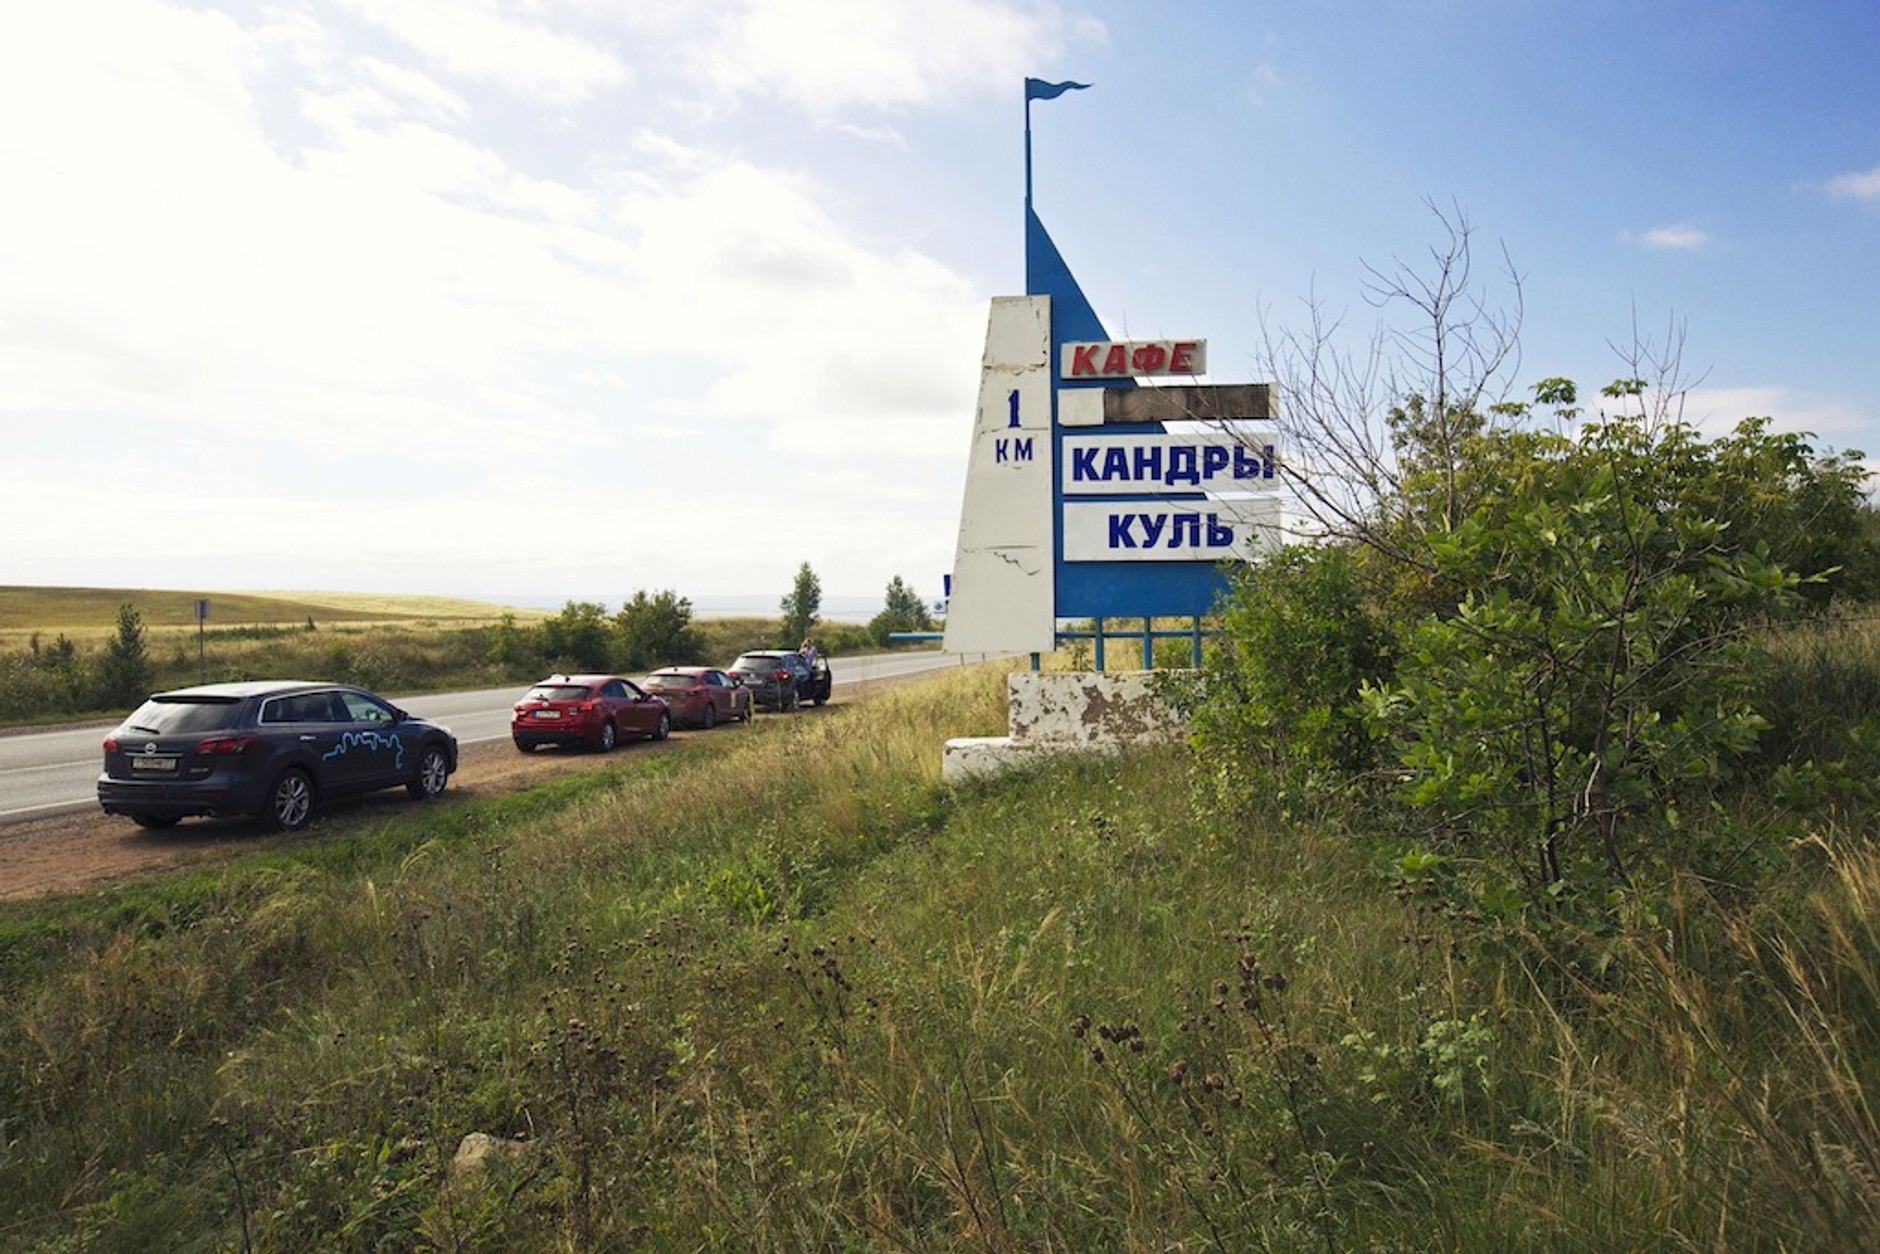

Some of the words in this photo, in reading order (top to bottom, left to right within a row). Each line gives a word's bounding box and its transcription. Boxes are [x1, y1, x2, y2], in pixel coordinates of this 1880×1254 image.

[1071, 342, 1197, 375] КАФЕ
[1008, 389, 1021, 428] 1
[1072, 444, 1274, 486] КАНДРЫ
[1108, 512, 1235, 549] КУЛЬ
